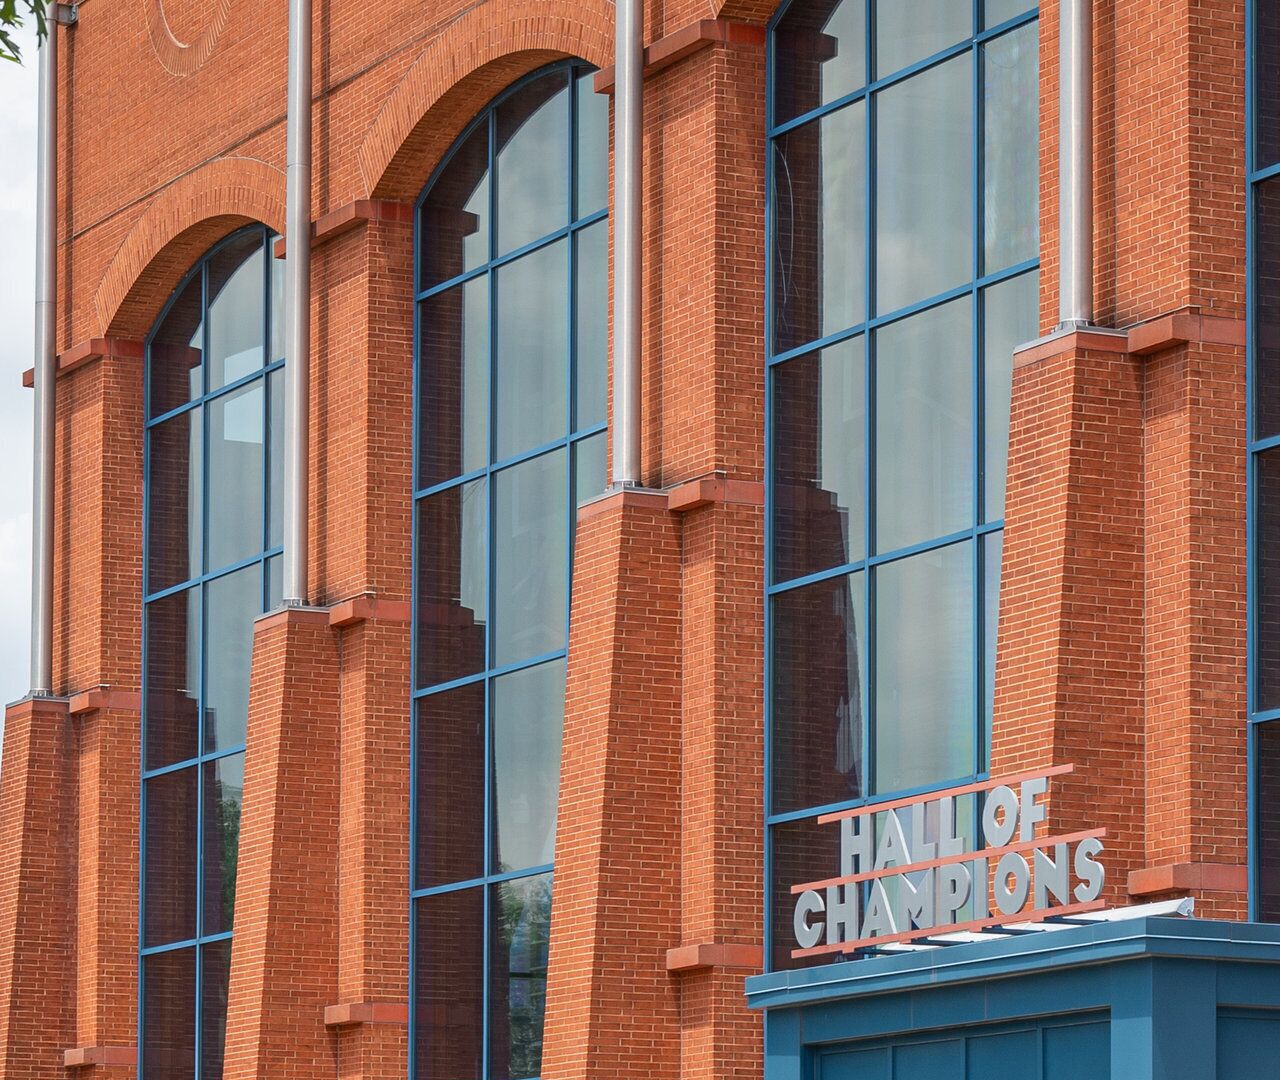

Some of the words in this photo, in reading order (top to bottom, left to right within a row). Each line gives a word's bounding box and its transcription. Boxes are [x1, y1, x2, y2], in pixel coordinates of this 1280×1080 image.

[841, 796, 966, 876] HALL
[982, 777, 1047, 848] OF
[793, 837, 1106, 949] CHAMPIONS
